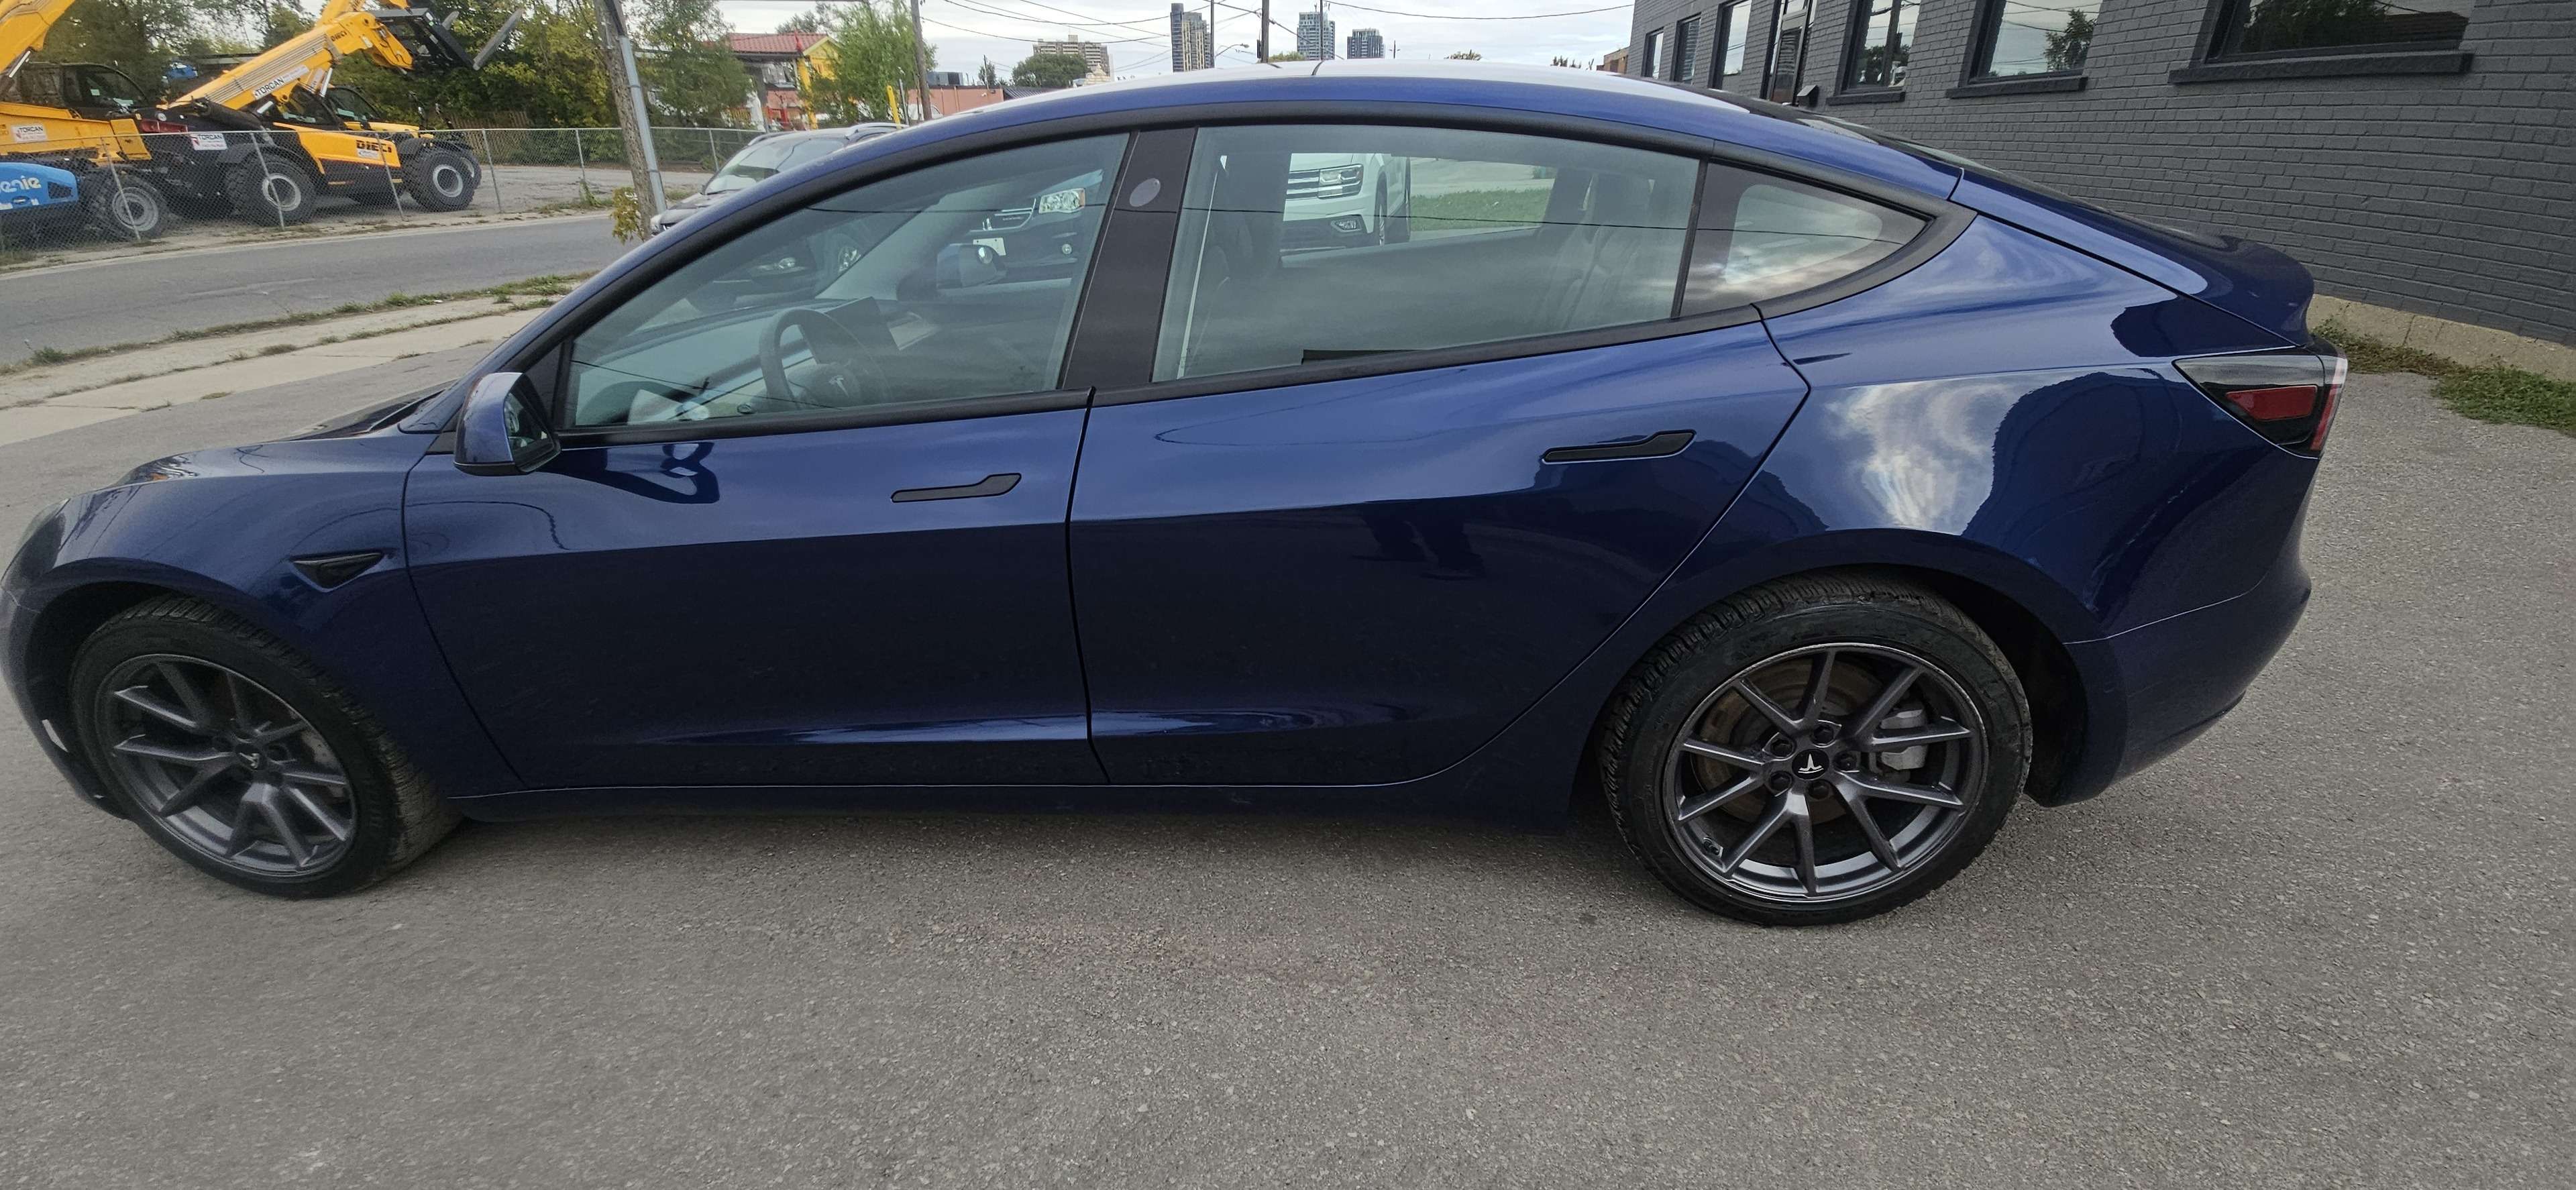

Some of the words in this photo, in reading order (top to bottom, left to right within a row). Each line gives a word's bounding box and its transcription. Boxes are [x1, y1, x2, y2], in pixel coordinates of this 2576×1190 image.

[256, 76, 284, 95] TORCAN
[356, 140, 392, 153] DIECI
[0, 175, 42, 193] enie
